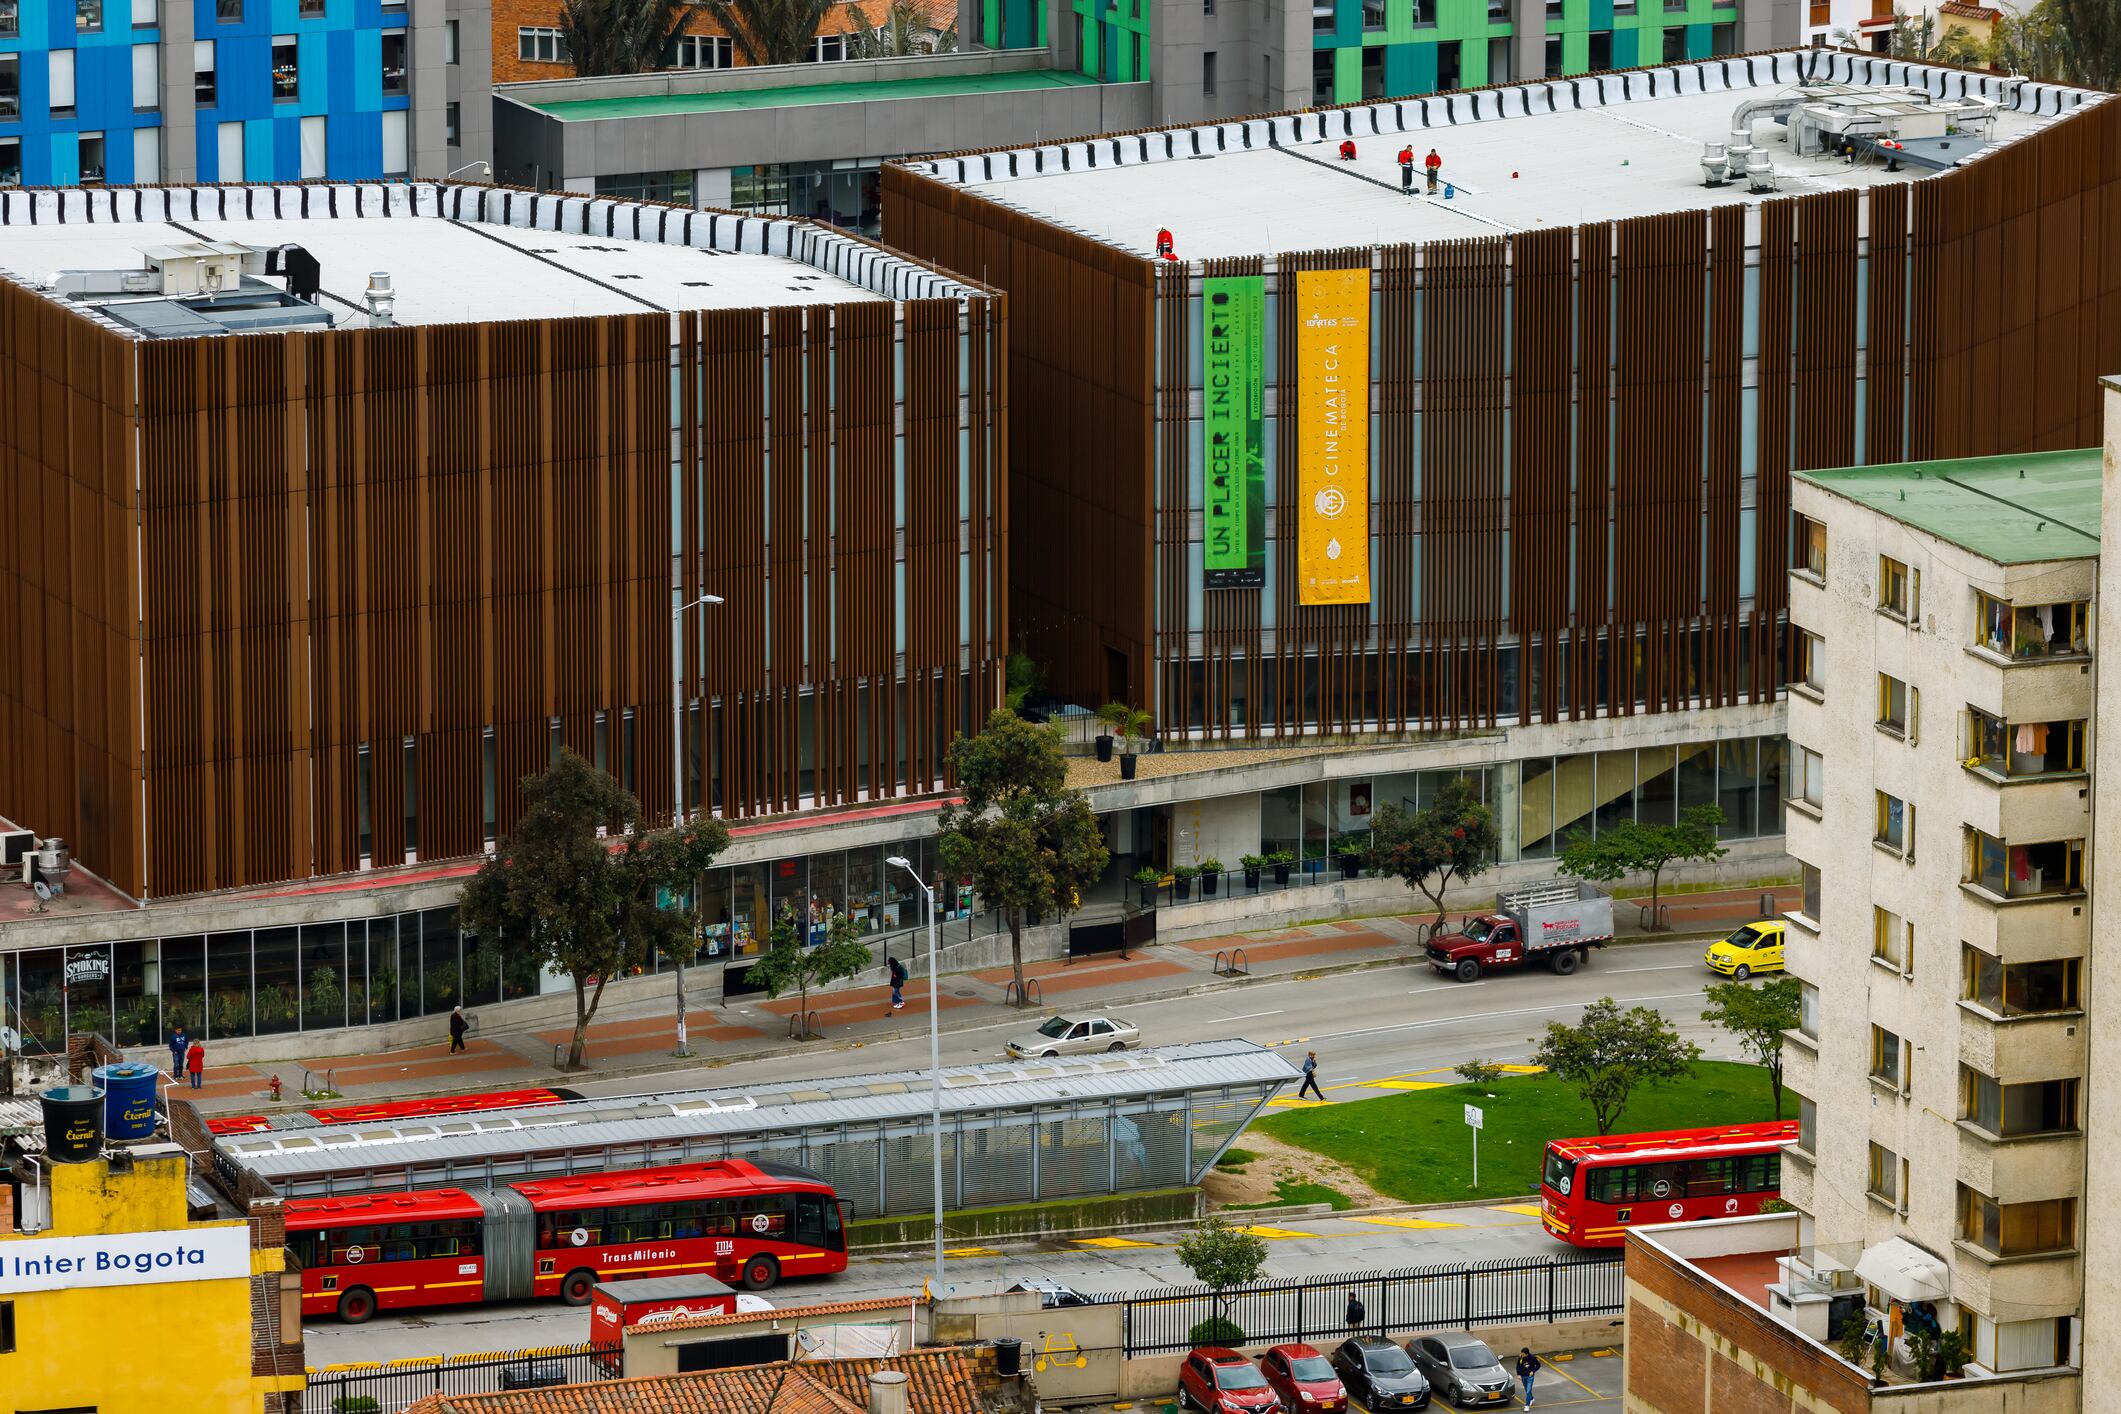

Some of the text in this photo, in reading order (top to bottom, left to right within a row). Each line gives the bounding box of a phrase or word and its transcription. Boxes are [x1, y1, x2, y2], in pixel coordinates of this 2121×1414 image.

[1211, 292, 1230, 420] INCIERTO
[1325, 344, 1338, 476] CINEMATECA
[1339, 389, 1347, 431] DE BOGOTÁ
[1211, 431, 1230, 517] PLACER
[1212, 526, 1230, 556] UN
[66, 960, 109, 978] SMOKING
[123, 1109, 152, 1121] Eternit
[65, 1129, 95, 1141] Eternit
[602, 1249, 677, 1263] TransMilenio
[716, 1240, 733, 1250] T1114
[15, 1255, 86, 1276] Inter
[96, 1246, 204, 1273] Bogota
[648, 1304, 714, 1314] HUEVOS
